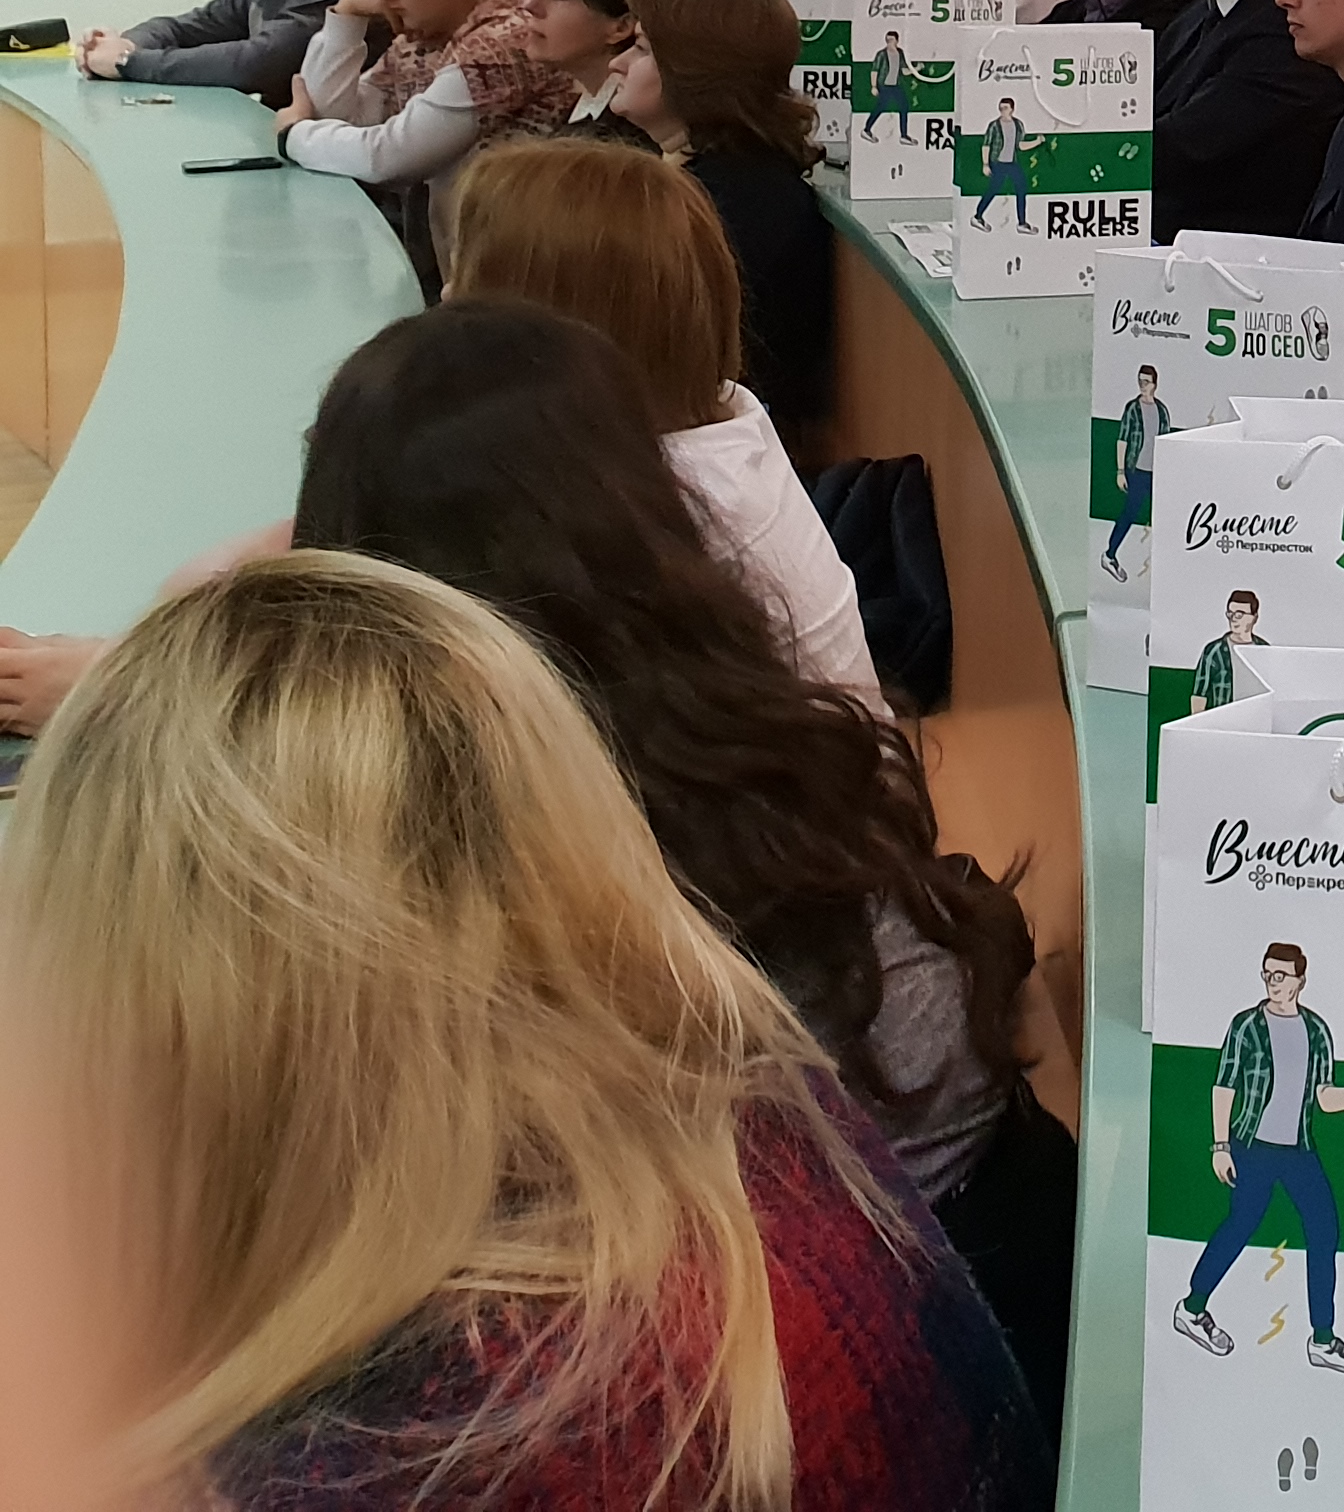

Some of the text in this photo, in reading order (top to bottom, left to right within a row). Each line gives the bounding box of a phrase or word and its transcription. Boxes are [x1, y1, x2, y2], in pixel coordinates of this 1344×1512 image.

[931, 0, 950, 23] 5
[803, 71, 851, 88] RUL
[1052, 58, 1075, 87] 5
[804, 87, 851, 99] MAKE
[926, 118, 955, 139] RU
[1048, 199, 1139, 224] RULE
[1047, 218, 1139, 239] MAKERS
[1112, 299, 1182, 334] Вместе
[1205, 308, 1292, 356] 5 ШАГОВ
[1242, 333, 1266, 358] ДО
[1185, 502, 1298, 551] Вместе
